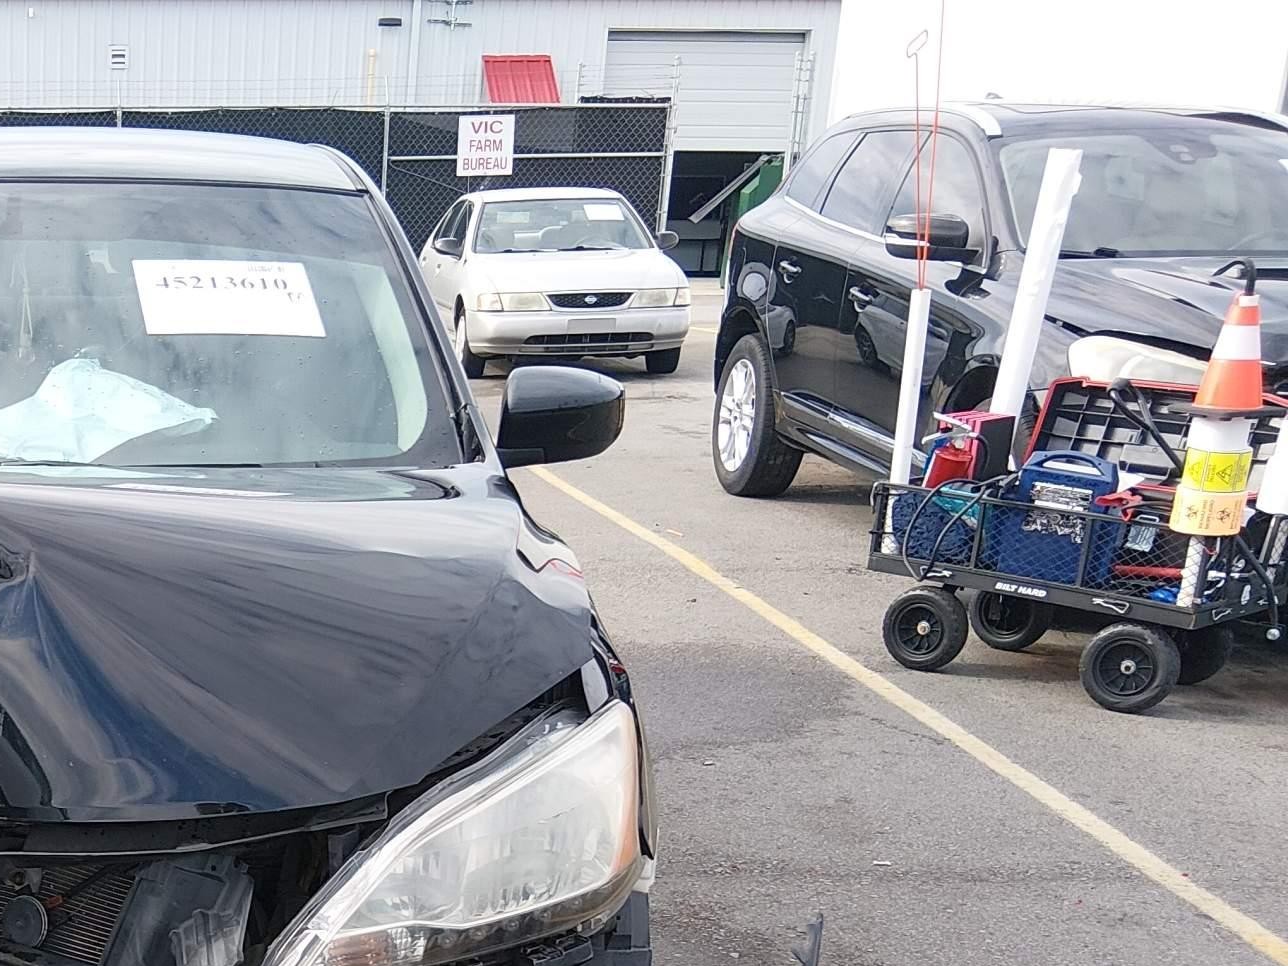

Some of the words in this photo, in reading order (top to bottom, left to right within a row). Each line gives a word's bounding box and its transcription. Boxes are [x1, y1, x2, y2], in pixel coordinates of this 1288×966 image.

[471, 120, 504, 134] VIC
[469, 139, 503, 153] FARM
[462, 157, 508, 171] BUREAU
[155, 275, 289, 290] 45213610
[995, 581, 1018, 592] BILT
[1017, 586, 1048, 598] HARD
